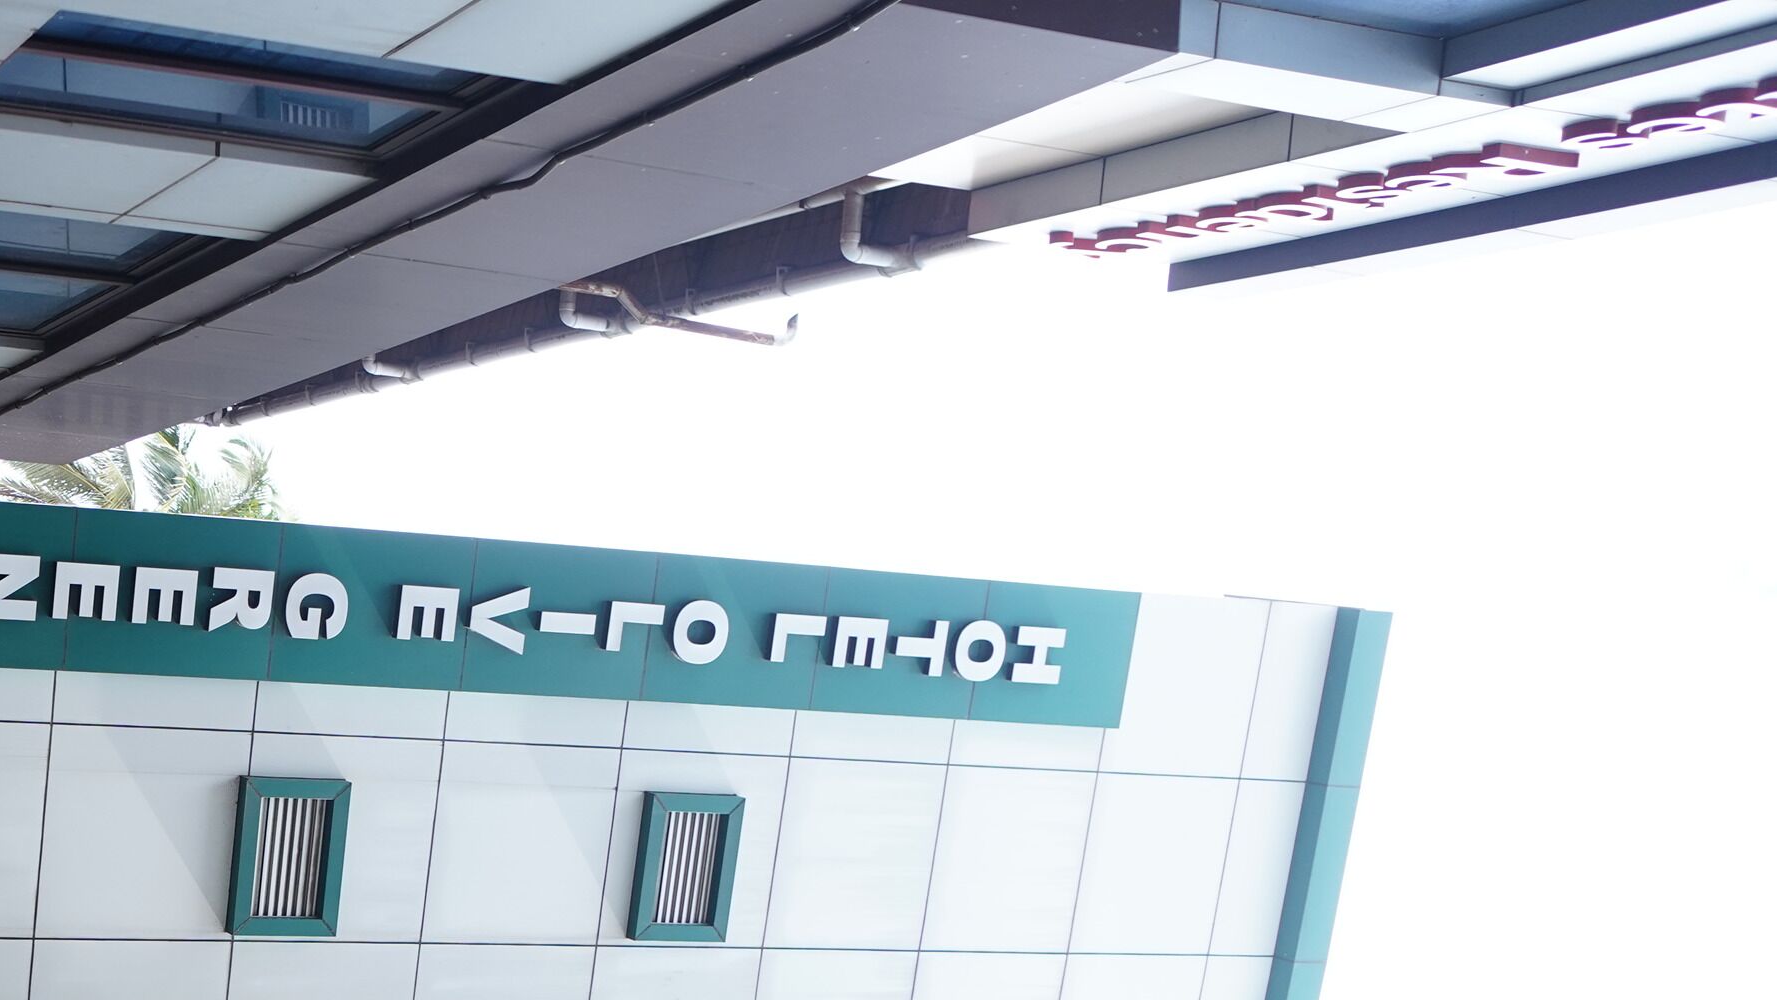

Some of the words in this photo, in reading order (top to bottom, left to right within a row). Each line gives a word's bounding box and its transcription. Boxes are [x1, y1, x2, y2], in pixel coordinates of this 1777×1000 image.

[1048, 143, 1580, 265] Residency
[393, 584, 730, 665] OLIVE
[769, 613, 1067, 685] HOTEL
